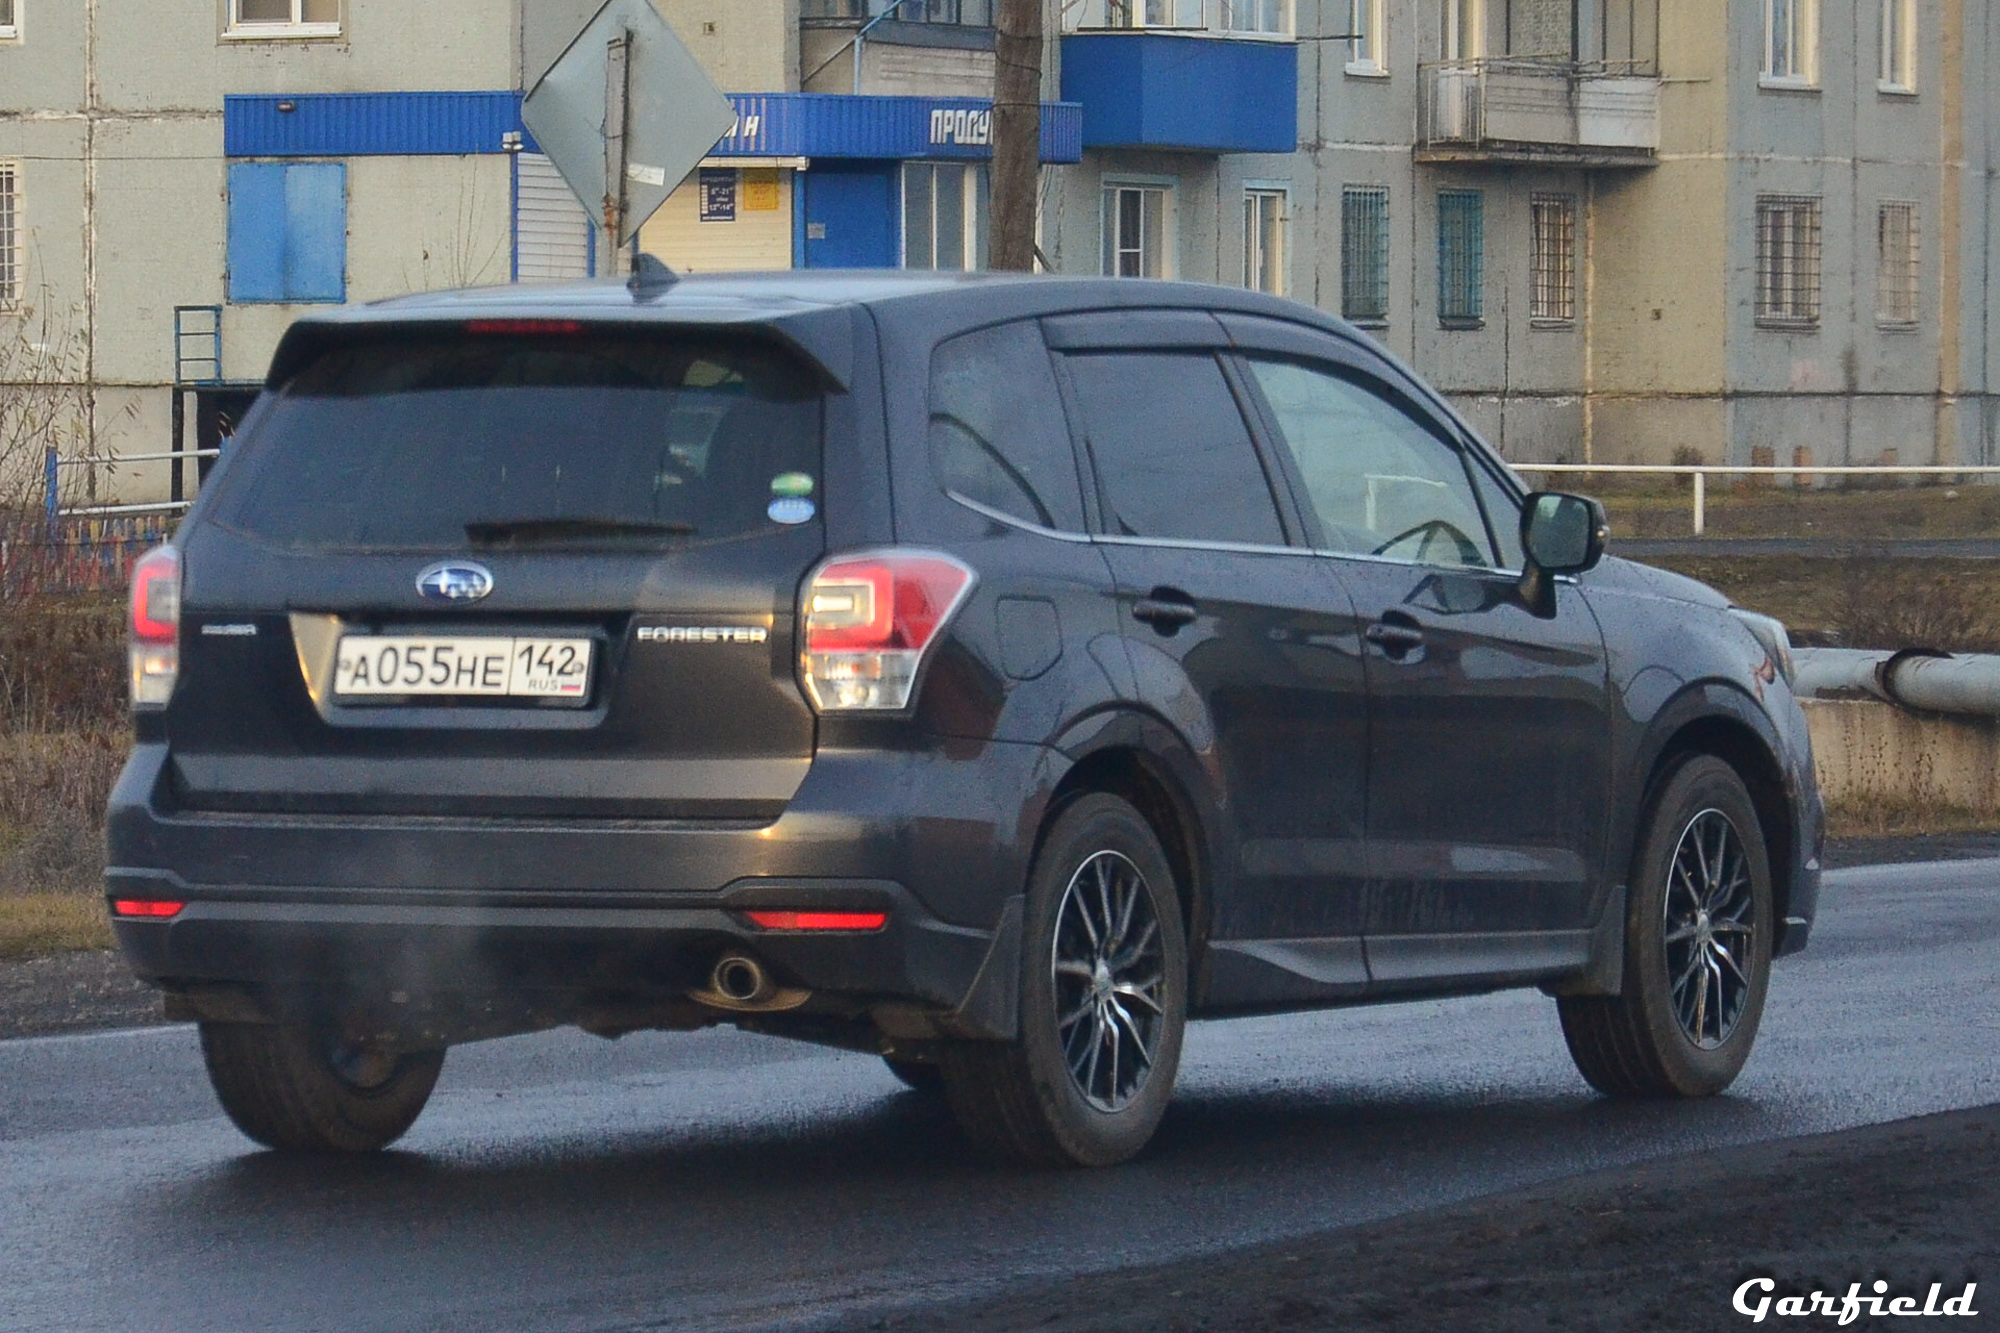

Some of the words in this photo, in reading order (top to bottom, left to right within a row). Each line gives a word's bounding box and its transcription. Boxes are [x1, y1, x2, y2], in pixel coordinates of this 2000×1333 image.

[637, 626, 767, 643] FORESTER
[350, 645, 505, 688] А055НЕ
[517, 644, 578, 678] 142
[528, 678, 559, 691] RUS
